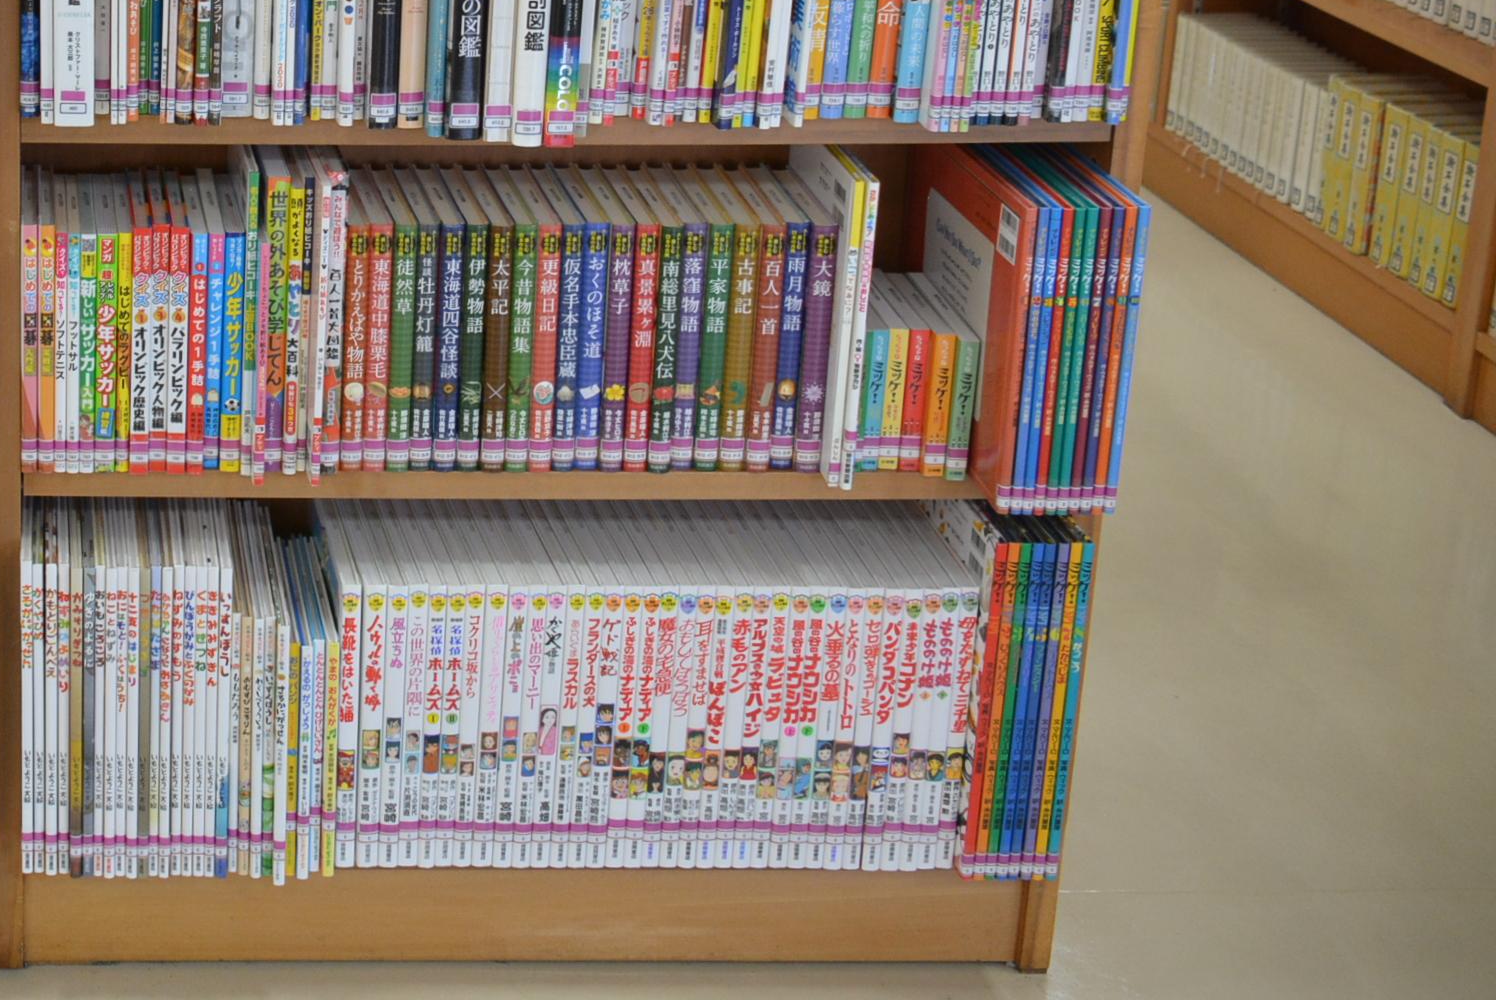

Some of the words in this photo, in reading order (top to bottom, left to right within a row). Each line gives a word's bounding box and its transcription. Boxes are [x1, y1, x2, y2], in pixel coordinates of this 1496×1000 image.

[266, 190, 290, 387] 世界の外あそび学じてん
[396, 259, 414, 315] 徒然草
[466, 259, 486, 335] 伊勢物語
[490, 260, 510, 316] 太平記
[512, 259, 533, 354] 今昔物語集
[538, 259, 558, 333] 更級日記
[583, 258, 604, 359] おくのほそ道
[611, 259, 631, 315] 枕草子
[680, 258, 702, 334] 落窪物語
[706, 259, 729, 334] 平家物語
[734, 259, 754, 315] 古事記
[760, 260, 781, 336] 百人一首
[782, 257, 806, 332] 雨月物語
[811, 261, 834, 297] 大鏡
[347, 261, 366, 379] とりかえばや物語
[368, 259, 390, 379] 東海道中膝栗毛
[440, 259, 462, 379] 東海道四谷怪談
[558, 258, 581, 378] 仮名手本忠臣蔵
[655, 261, 679, 379] 南総里見八犬伝
[133, 326, 147, 432] オリンピック歴史編
[151, 323, 166, 430] オリンピック人物編
[170, 326, 185, 424] パラリンピック編
[730, 618, 751, 693] 赤毛のアン
[820, 621, 845, 701] 火垂るの墓
[918, 620, 938, 689] もののけ姫
[935, 618, 953, 688] もののけ姫
